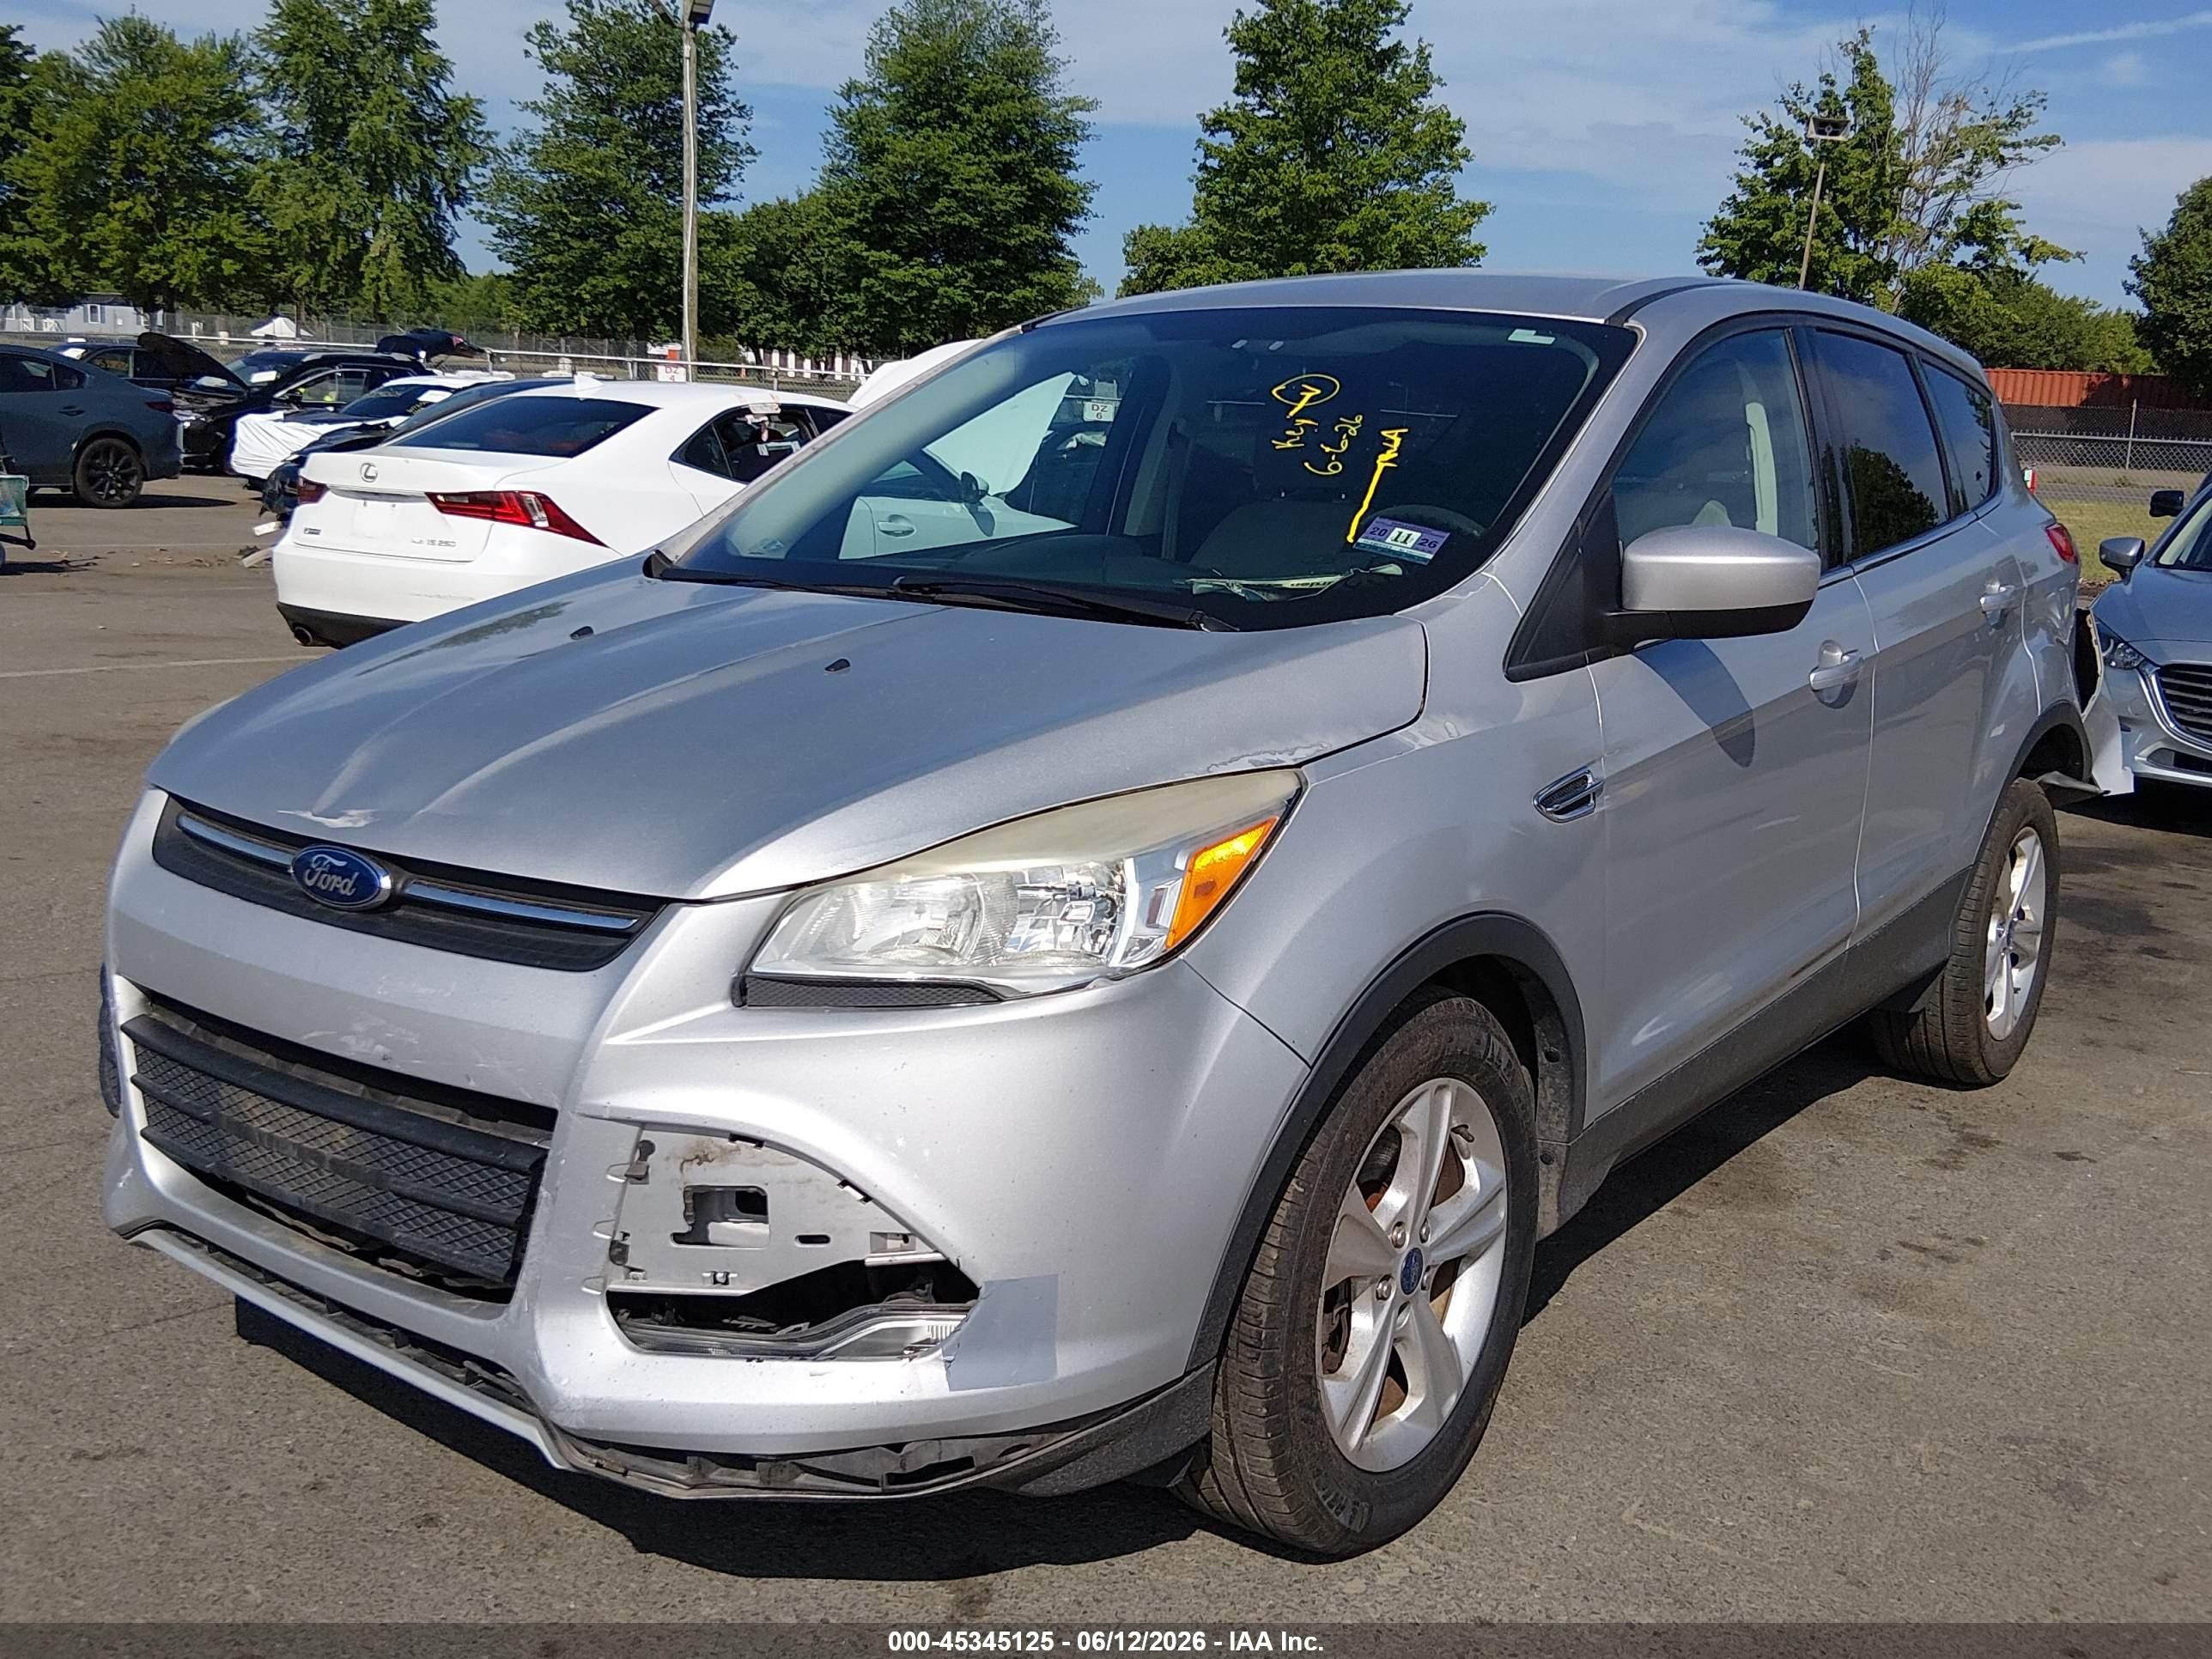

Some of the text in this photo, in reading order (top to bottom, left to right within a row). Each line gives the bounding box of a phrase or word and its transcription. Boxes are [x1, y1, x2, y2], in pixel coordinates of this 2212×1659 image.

[1091, 404, 1108, 412] DZ
[1370, 526, 1389, 537] 20
[1391, 531, 1413, 545] 11
[1418, 538, 1440, 550] 26
[303, 854, 360, 896] Ford
